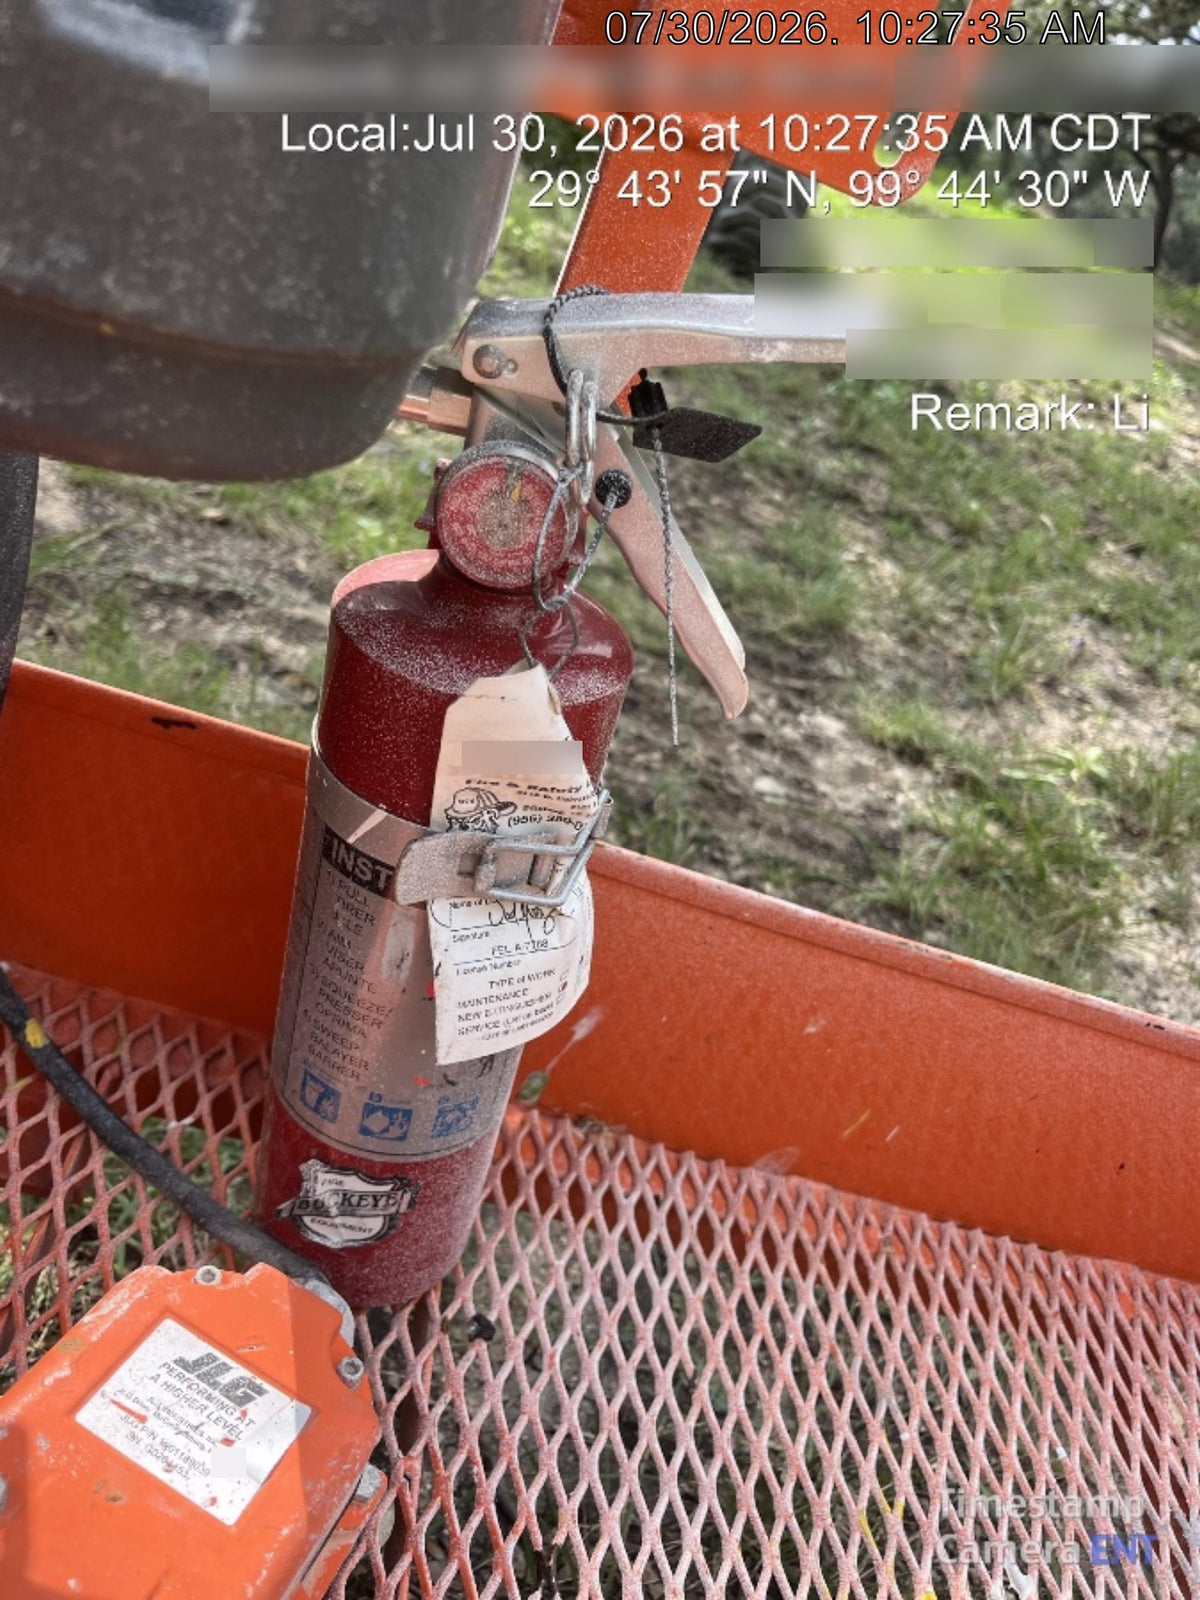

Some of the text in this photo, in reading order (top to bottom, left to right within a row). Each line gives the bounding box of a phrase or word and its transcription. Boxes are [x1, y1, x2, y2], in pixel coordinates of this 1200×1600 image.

[159, 1362, 237, 1419] PERFORMING
[173, 1352, 269, 1407] JLG
[161, 1380, 206, 1414] HIGHER
[206, 1410, 243, 1441] LEVEL
